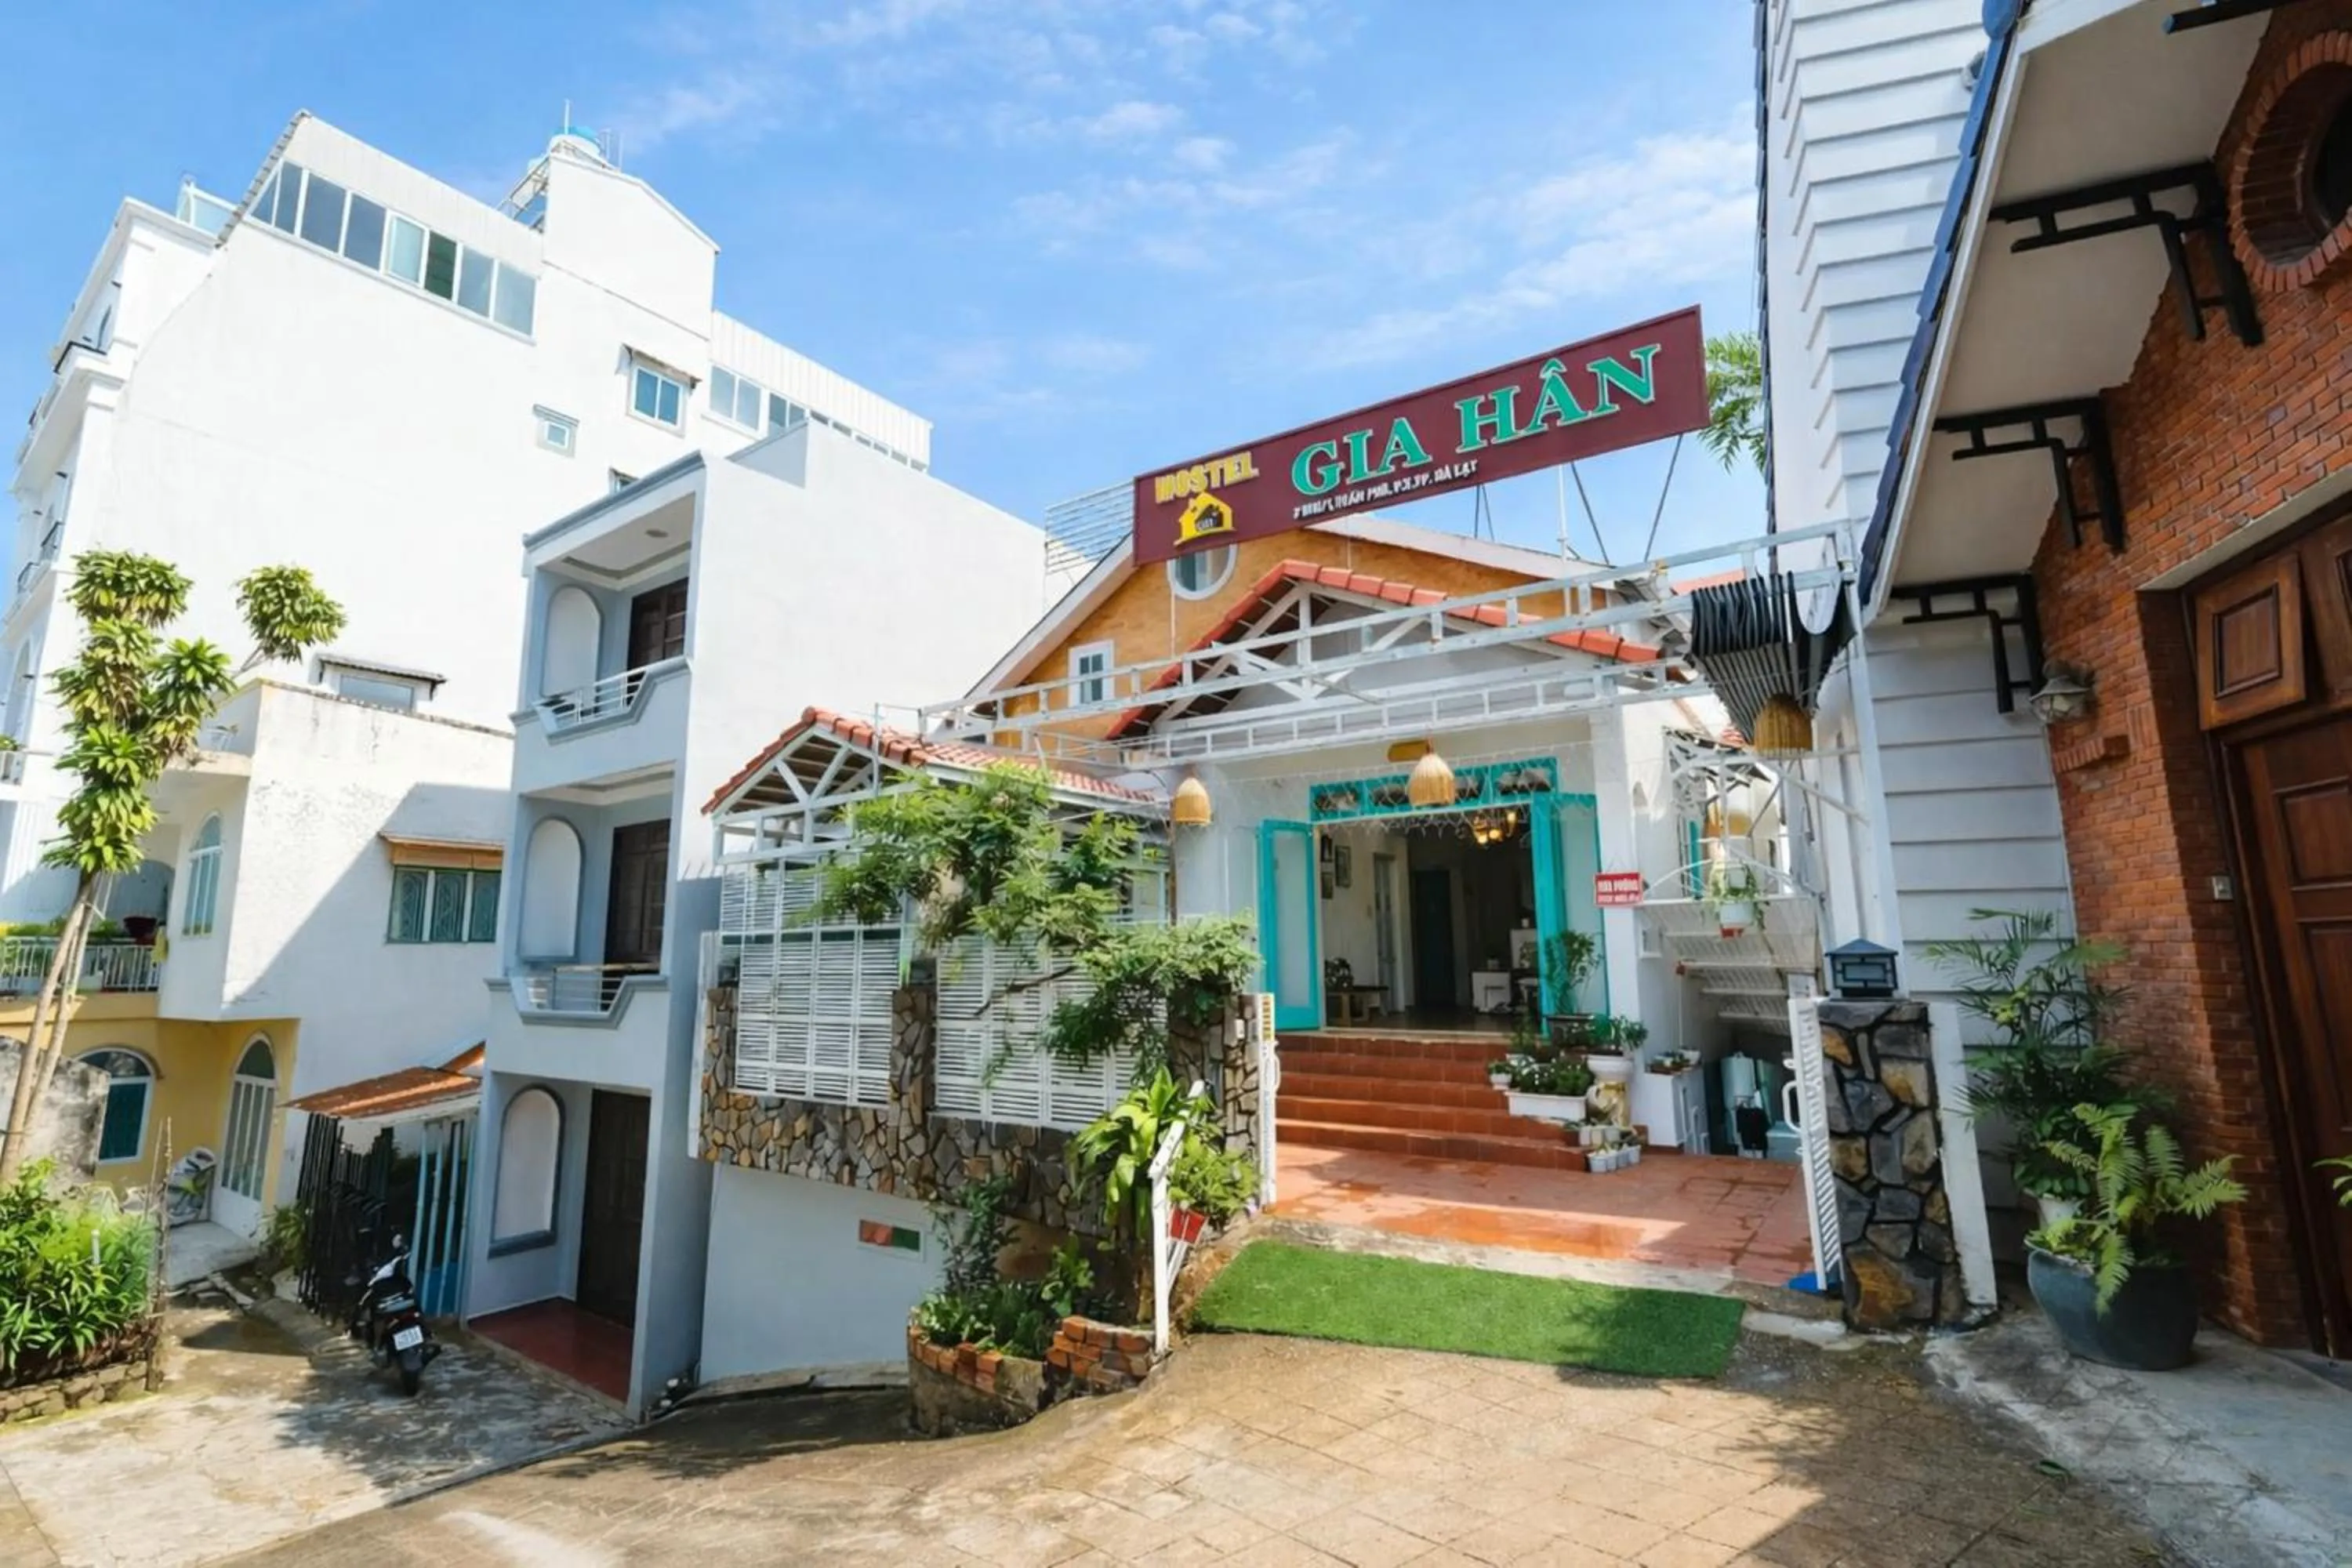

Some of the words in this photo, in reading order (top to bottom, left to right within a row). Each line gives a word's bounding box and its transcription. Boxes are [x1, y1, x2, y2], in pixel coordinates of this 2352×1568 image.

[1291, 417, 1432, 495] GIA
[1455, 343, 1661, 454] HÂN
[1155, 451, 1259, 503] HOSTEL
